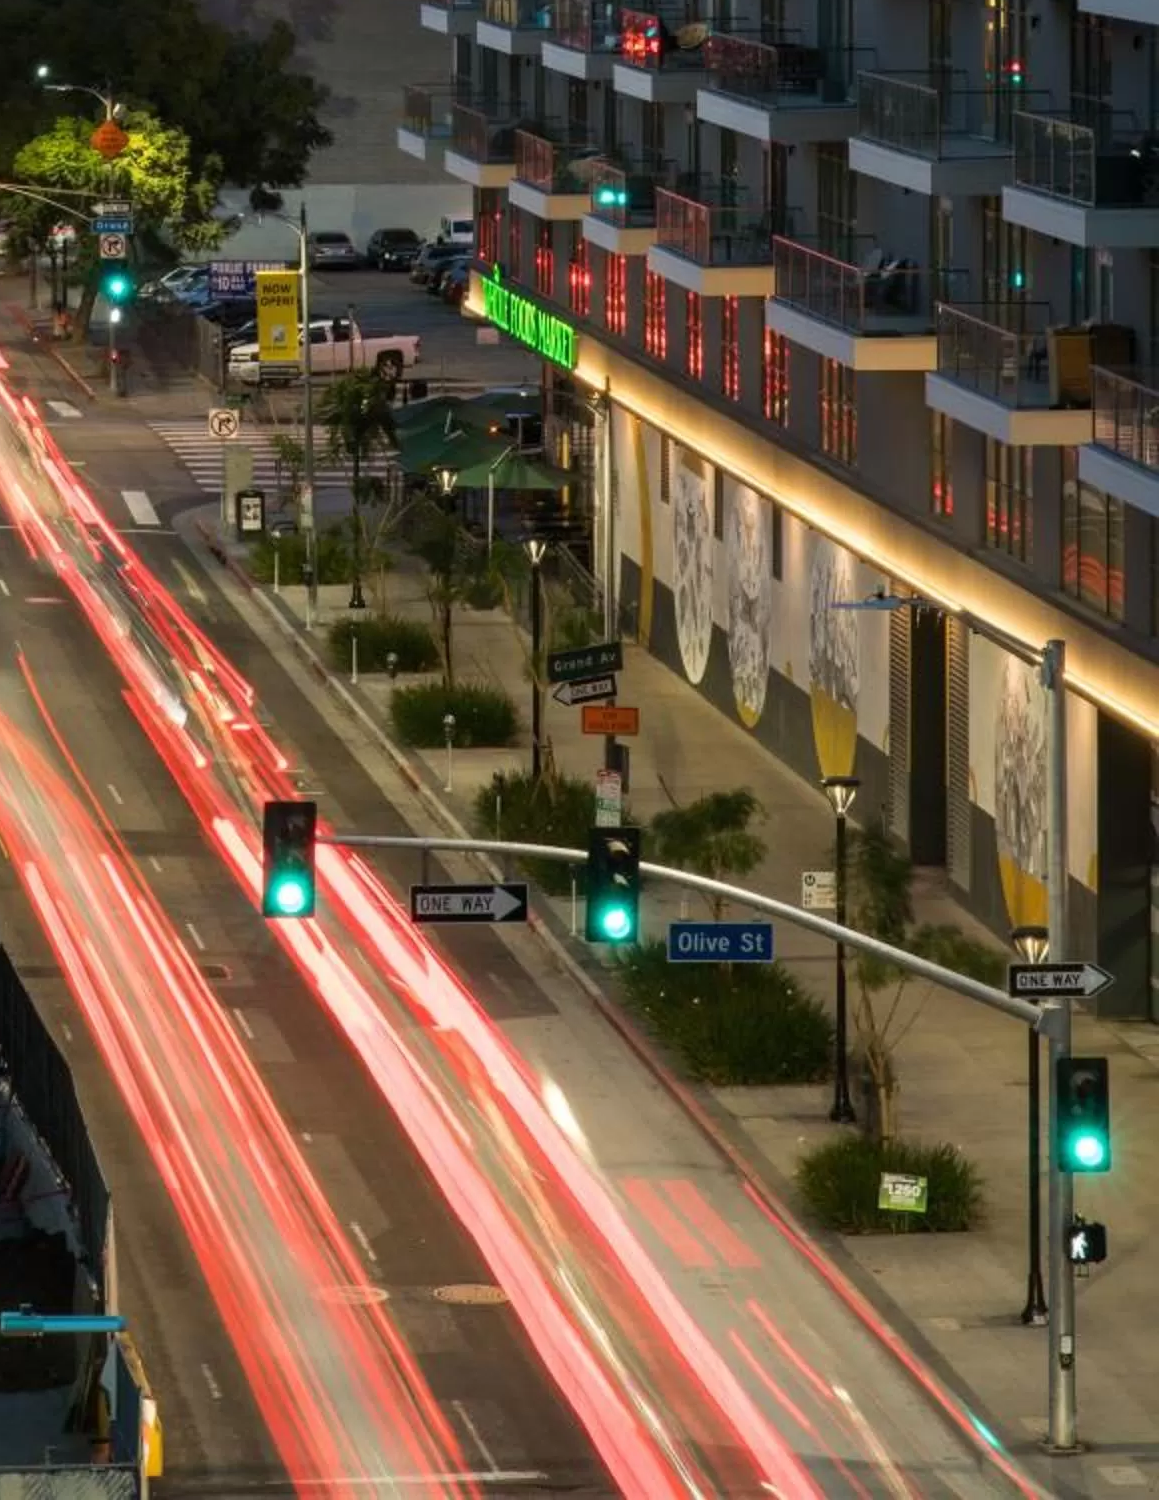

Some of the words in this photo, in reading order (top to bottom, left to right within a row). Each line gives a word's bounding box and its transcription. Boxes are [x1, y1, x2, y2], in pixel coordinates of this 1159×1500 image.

[262, 283, 291, 295] NOW
[554, 654, 594, 672] Grand
[420, 895, 451, 912] ONE
[461, 895, 493, 912] WAY
[677, 931, 730, 953] Olive
[740, 932, 766, 954] St
[1019, 975, 1049, 988] ONE
[1052, 973, 1081, 987] WAY
